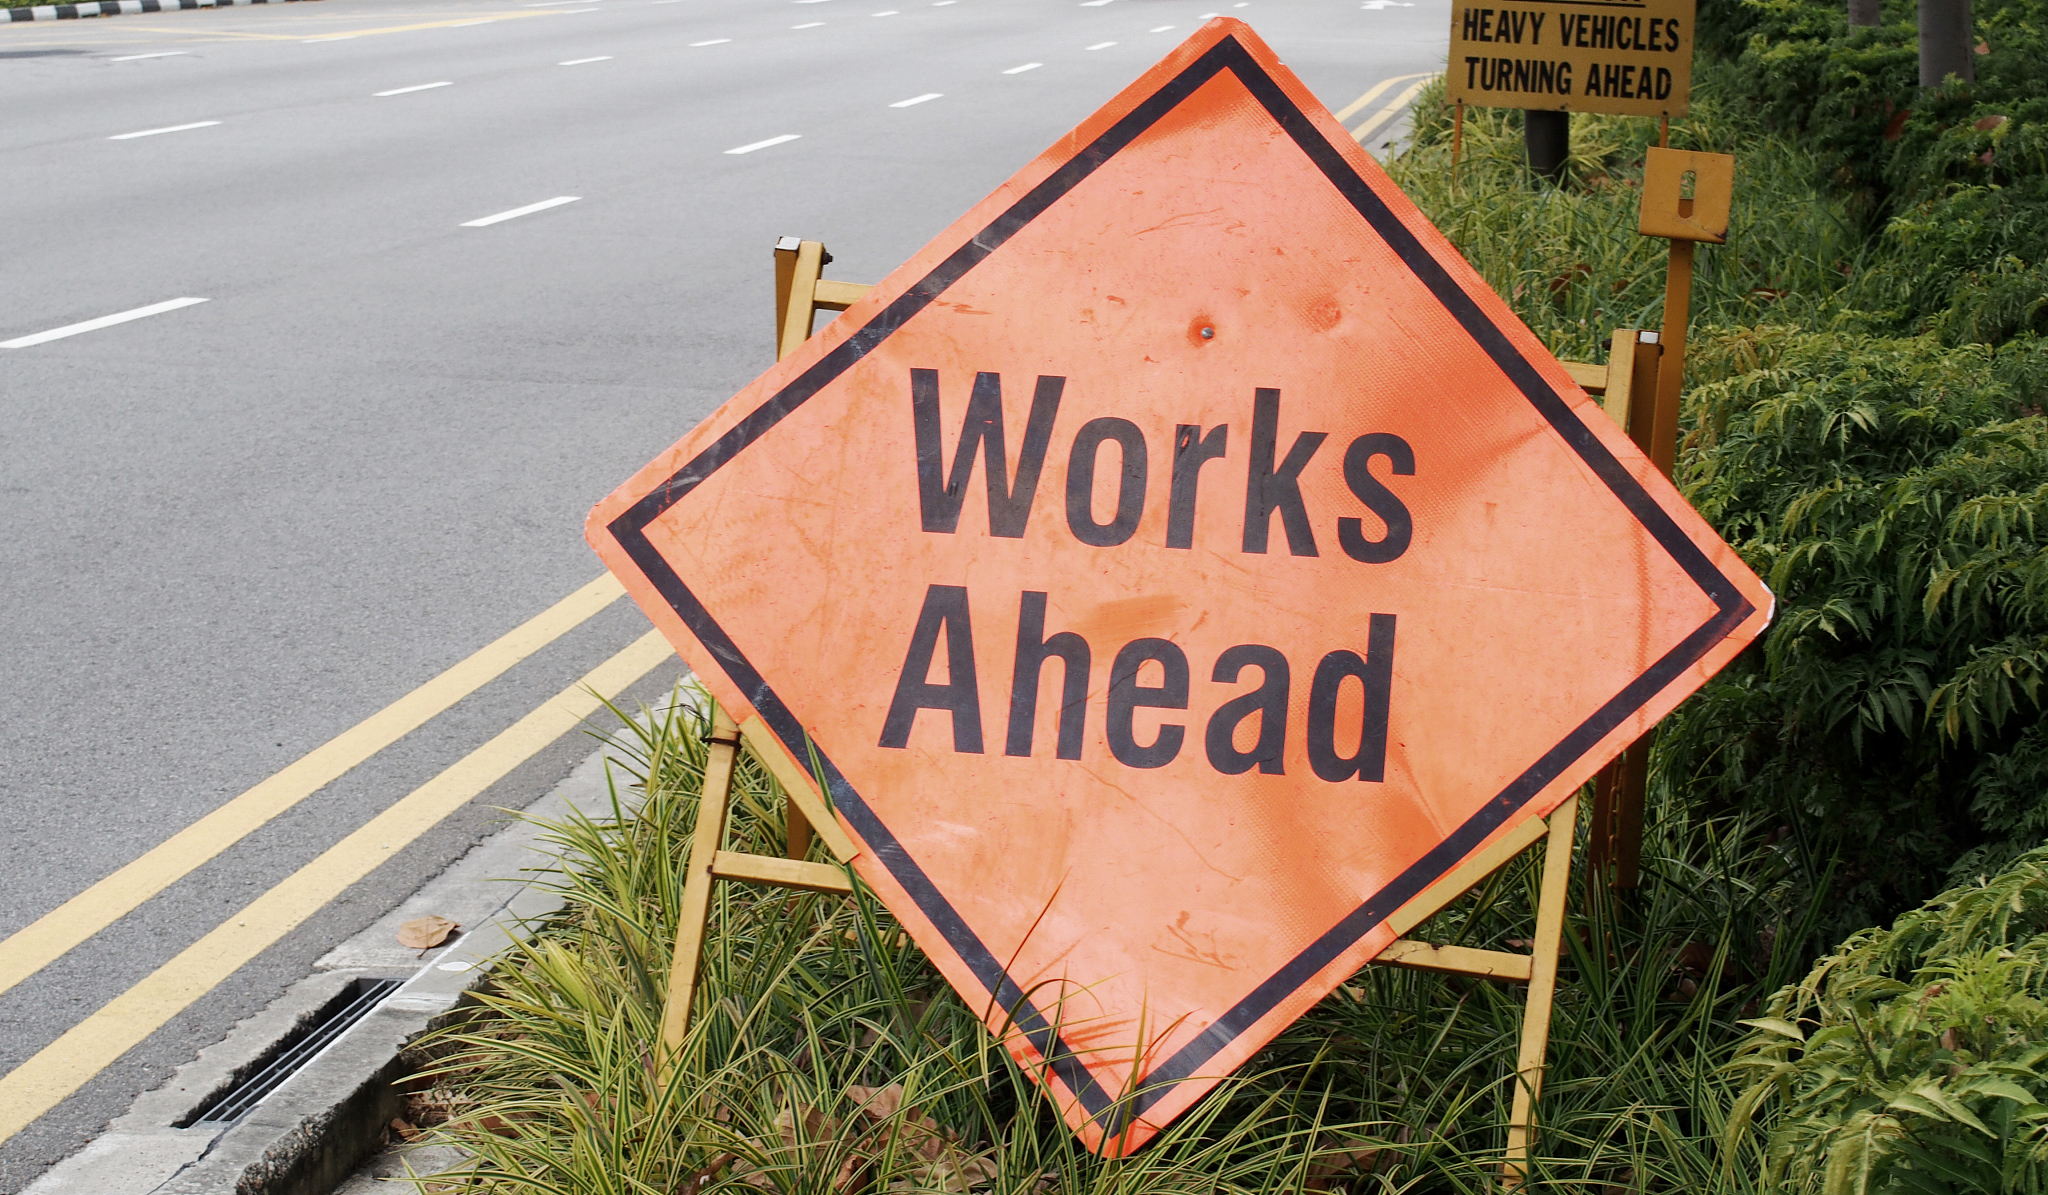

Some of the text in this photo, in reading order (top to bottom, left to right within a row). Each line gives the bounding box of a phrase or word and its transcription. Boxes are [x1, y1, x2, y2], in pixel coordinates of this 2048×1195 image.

[1462, 8, 1680, 52] HEAVY VEHICLES
[1465, 56, 1673, 101] TURNING AHEAD
[910, 367, 1416, 564] Works
[877, 584, 1398, 784] Ahead
